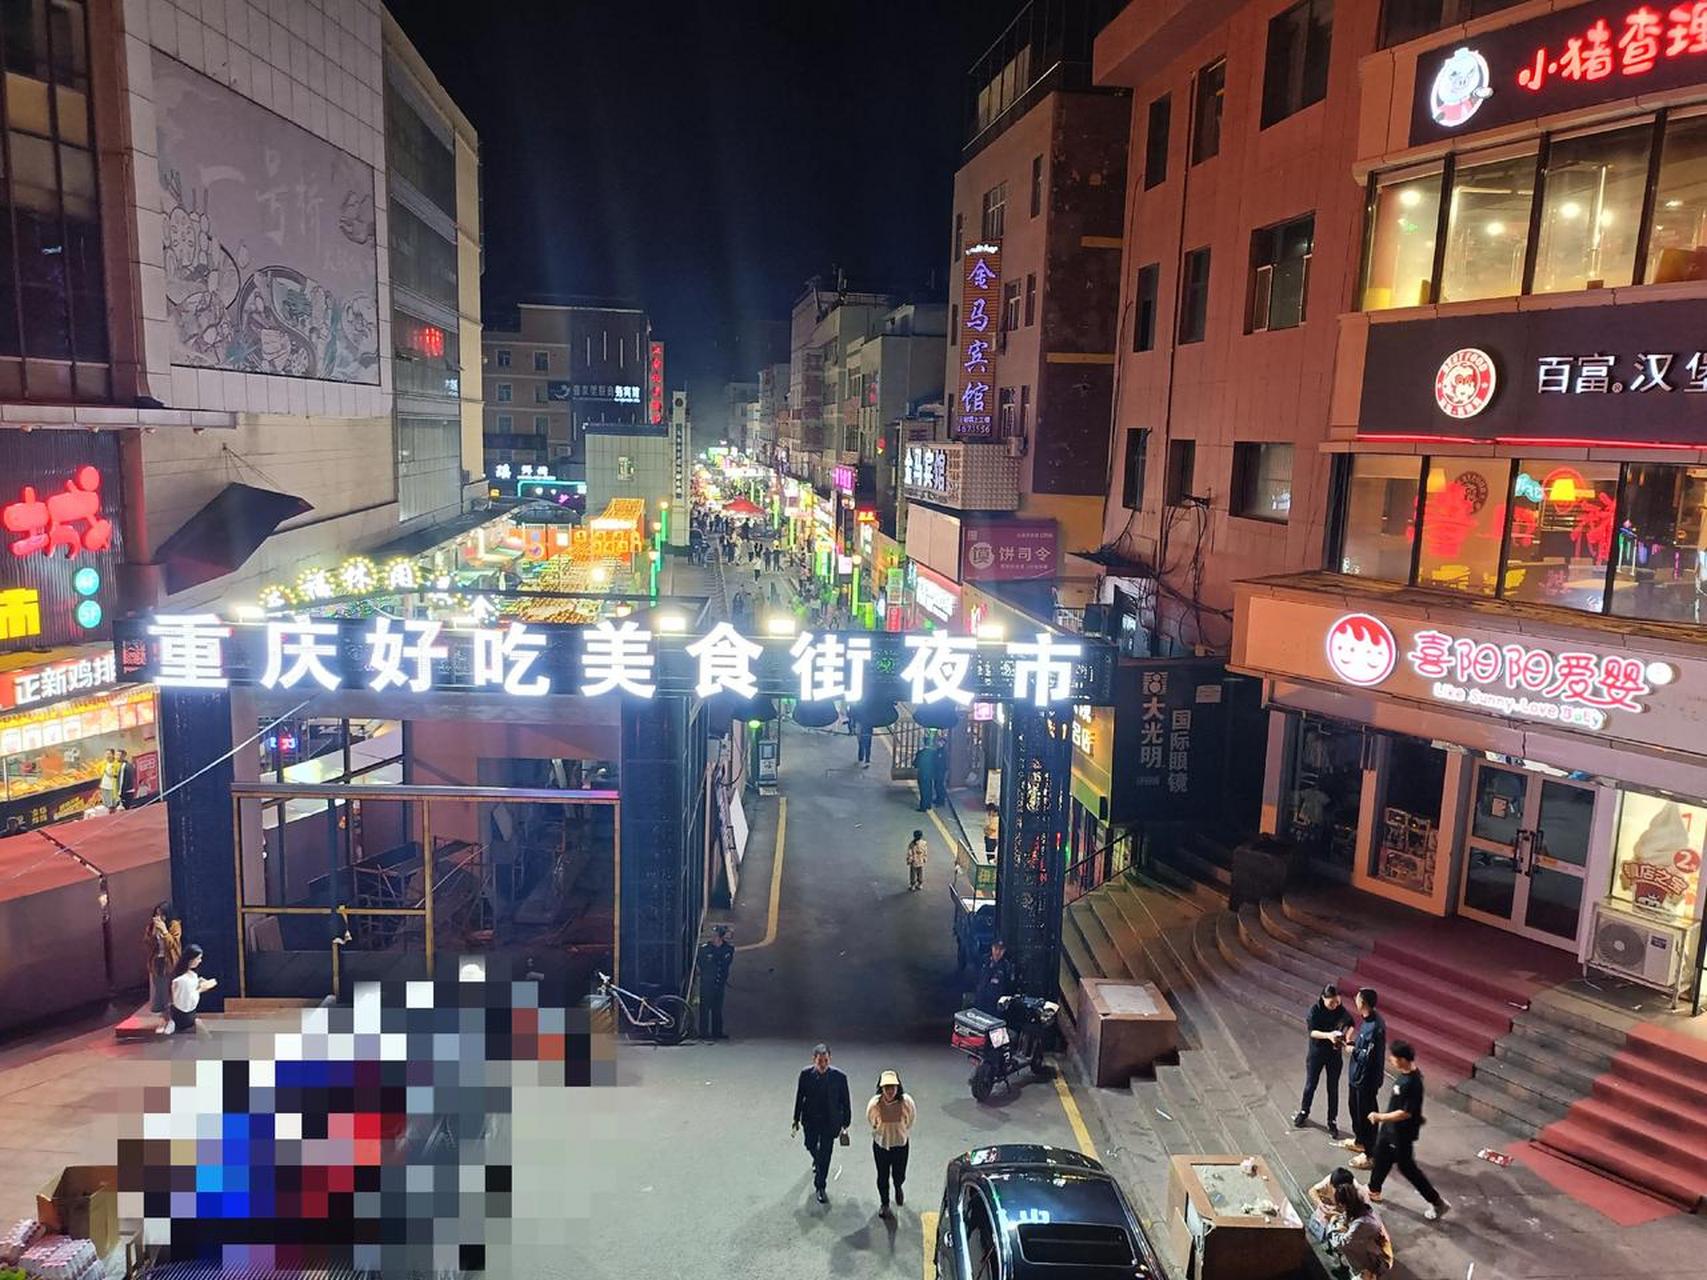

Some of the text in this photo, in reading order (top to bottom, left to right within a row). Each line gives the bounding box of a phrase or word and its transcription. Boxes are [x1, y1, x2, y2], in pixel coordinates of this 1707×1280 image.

[1518, 2, 1707, 90] 小猪查理
[963, 257, 997, 413] 金马宾馆
[904, 447, 947, 492] 金马宾馆
[998, 545, 1051, 563] 饼司令
[15, 651, 117, 705] 正新鸡排
[147, 612, 1083, 706] 重庆好吃美食街夜市
[1407, 630, 1650, 713] 喜阳阳爱婴
[1140, 697, 1167, 768] 大光明
[1167, 710, 1191, 793] 国际眼镜
